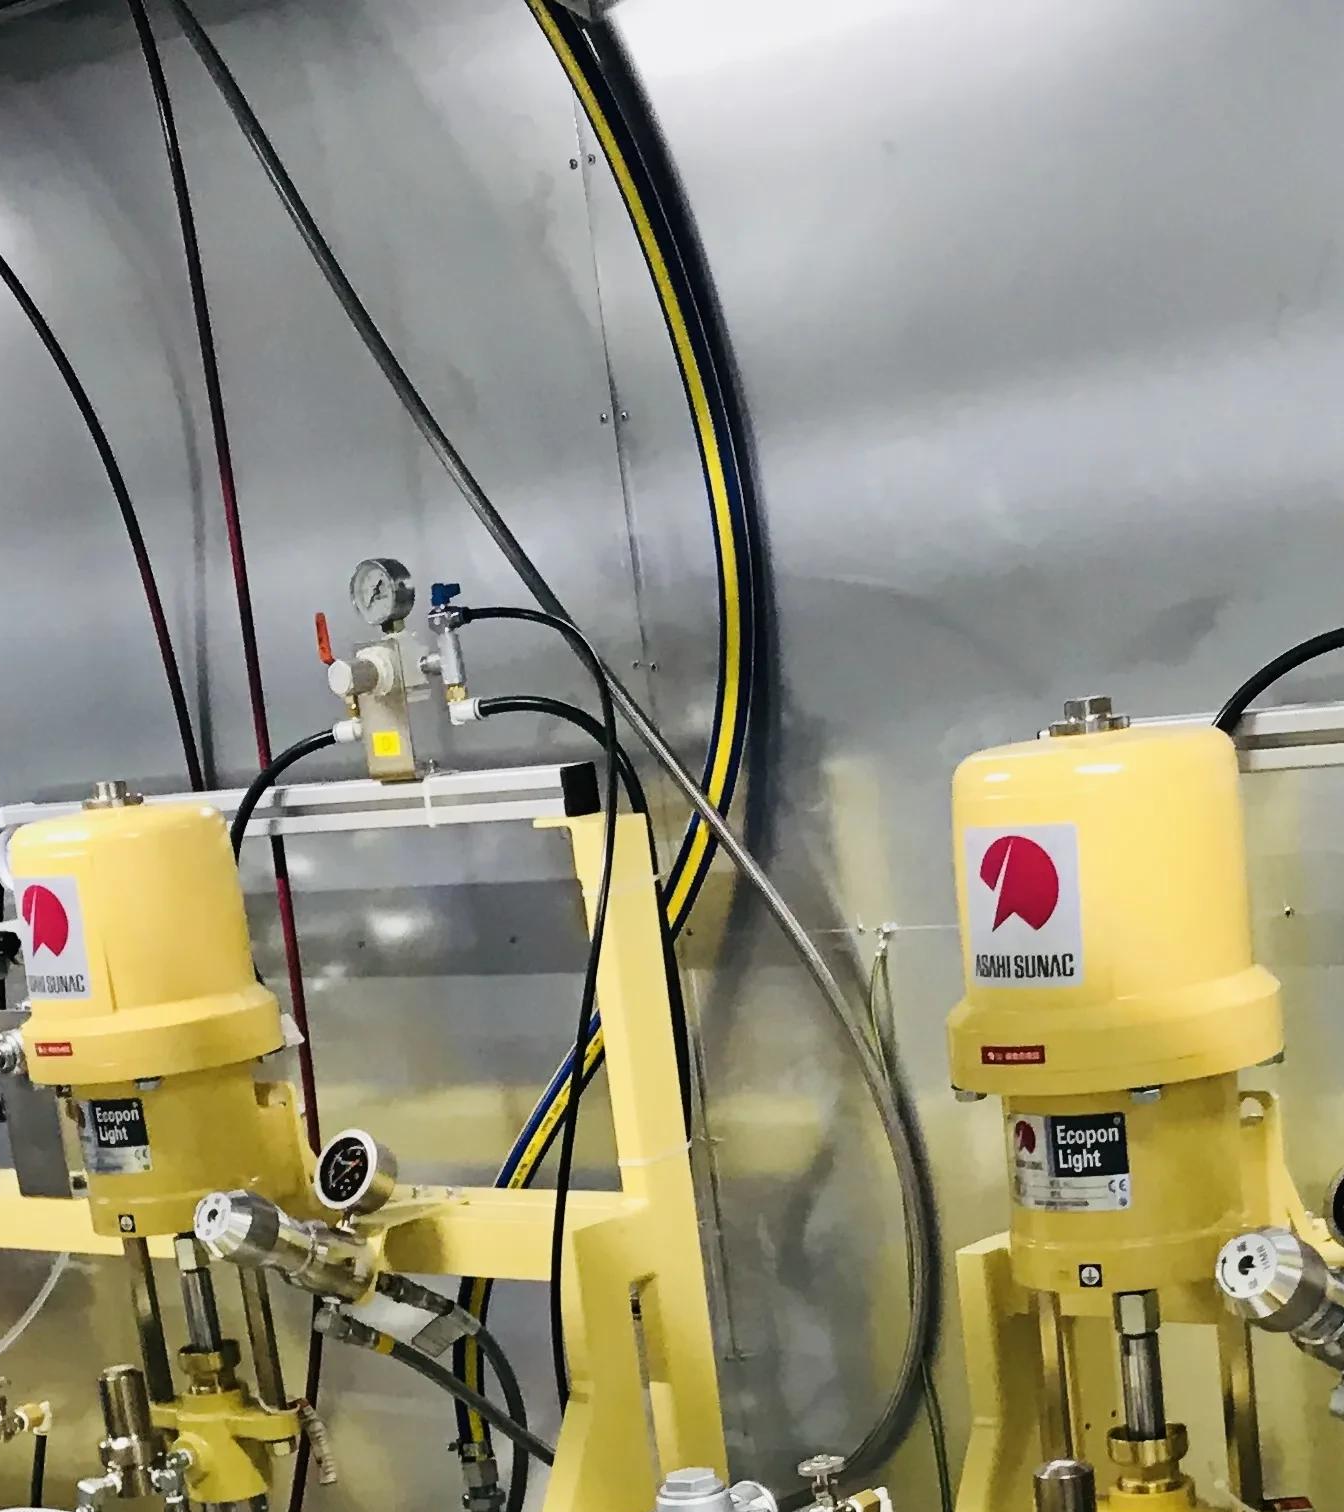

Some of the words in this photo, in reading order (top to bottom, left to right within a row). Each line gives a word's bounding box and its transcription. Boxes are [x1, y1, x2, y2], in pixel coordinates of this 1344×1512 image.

[975, 953, 1011, 979] ASAHI
[1014, 953, 1074, 979] SUNAC
[95, 1106, 140, 1126] Ecopon
[98, 1126, 129, 1145] Light
[1056, 1124, 1120, 1149] Ecopon
[1058, 1148, 1102, 1173] Light
